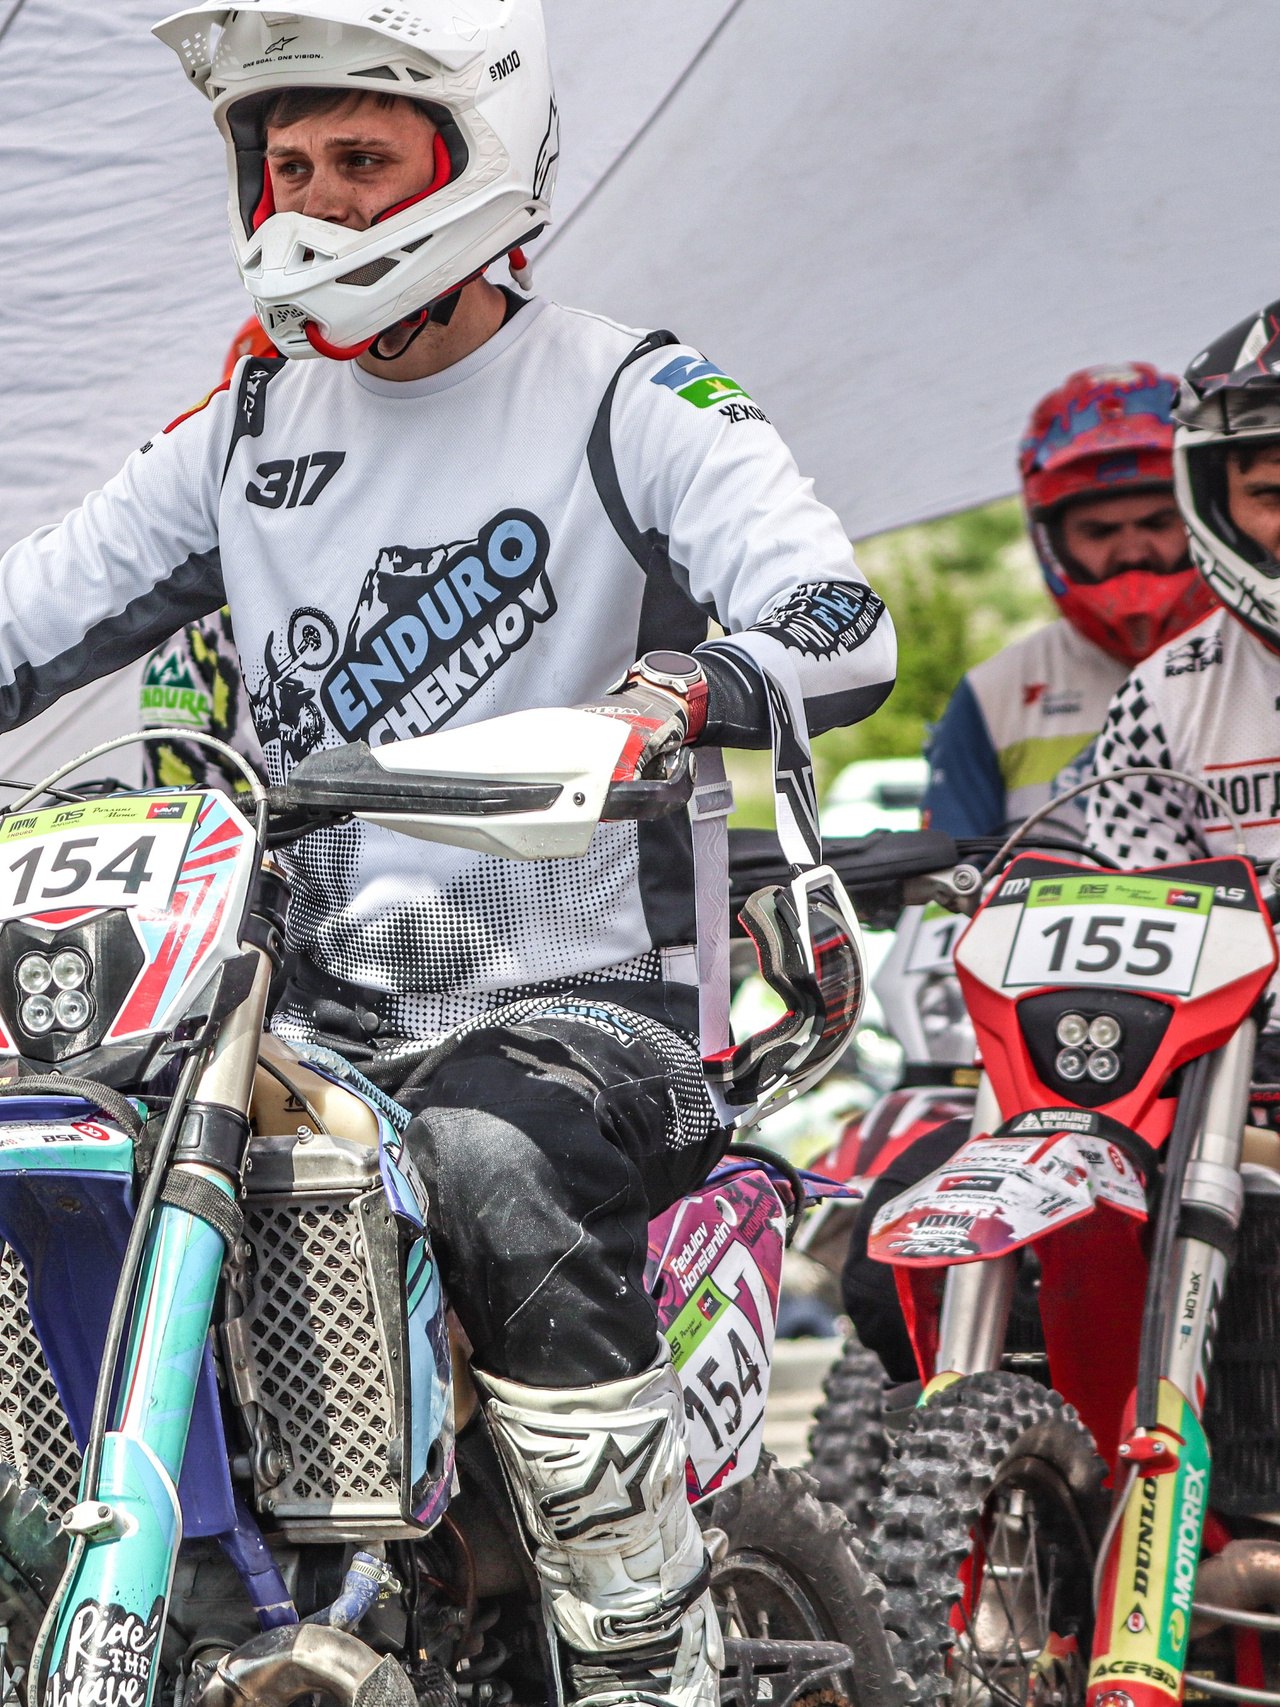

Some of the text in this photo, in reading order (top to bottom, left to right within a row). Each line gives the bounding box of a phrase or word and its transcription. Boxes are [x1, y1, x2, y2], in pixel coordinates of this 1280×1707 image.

[245, 451, 347, 510] 317
[327, 519, 538, 733] ENDURO
[368, 570, 551, 748] CHEKHOV
[8, 835, 157, 907] 154
[1041, 915, 1178, 976] 155
[1040, 1111, 1092, 1123] ENDURO
[1042, 1120, 1091, 1131] ELEMENT
[669, 1221, 709, 1279] Fedulov
[913, 1228, 968, 1237] ENDURO
[1182, 1271, 1203, 1320] XPLOR
[683, 1328, 763, 1451] 154
[1133, 1475, 1160, 1598] DUNLO
[1171, 1462, 1206, 1611] MOTOREX
[65, 1605, 160, 1681] Ride
[108, 1649, 152, 1680] THE
